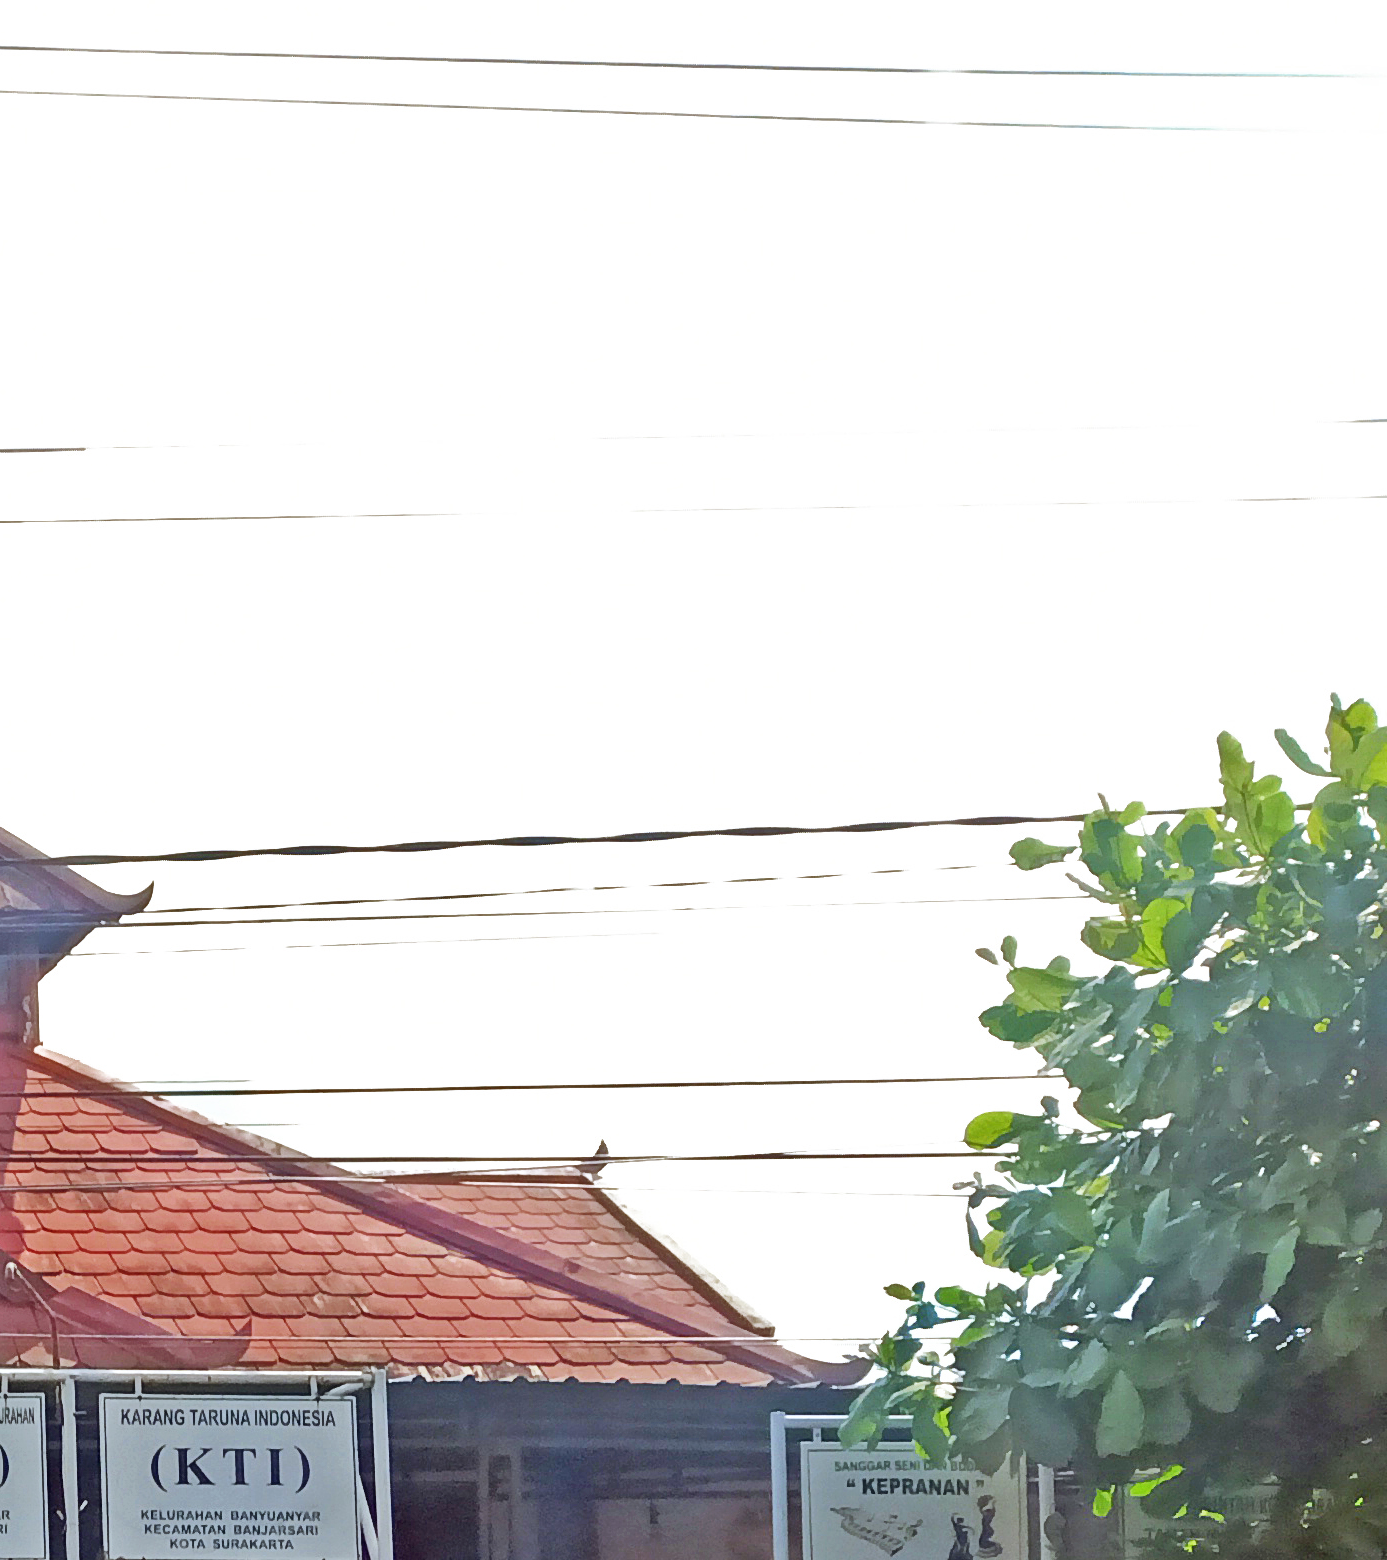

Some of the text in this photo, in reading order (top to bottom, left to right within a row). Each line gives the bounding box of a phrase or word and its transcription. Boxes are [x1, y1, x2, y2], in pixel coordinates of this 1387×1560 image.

[120, 1408, 336, 1427] KARANG TARUNA INDONESIA
[150, 1444, 311, 1494] (KTI)
[834, 1460, 891, 1473] SANGGAR
[894, 1460, 921, 1472] SENI
[861, 1477, 970, 1496] KEPRANAN
[140, 1509, 321, 1523] KELURAHAN BANYUANYAR
[144, 1523, 319, 1536] KECAMATAN BANJARSARI
[169, 1538, 295, 1550] KOTA SURAKARTA
